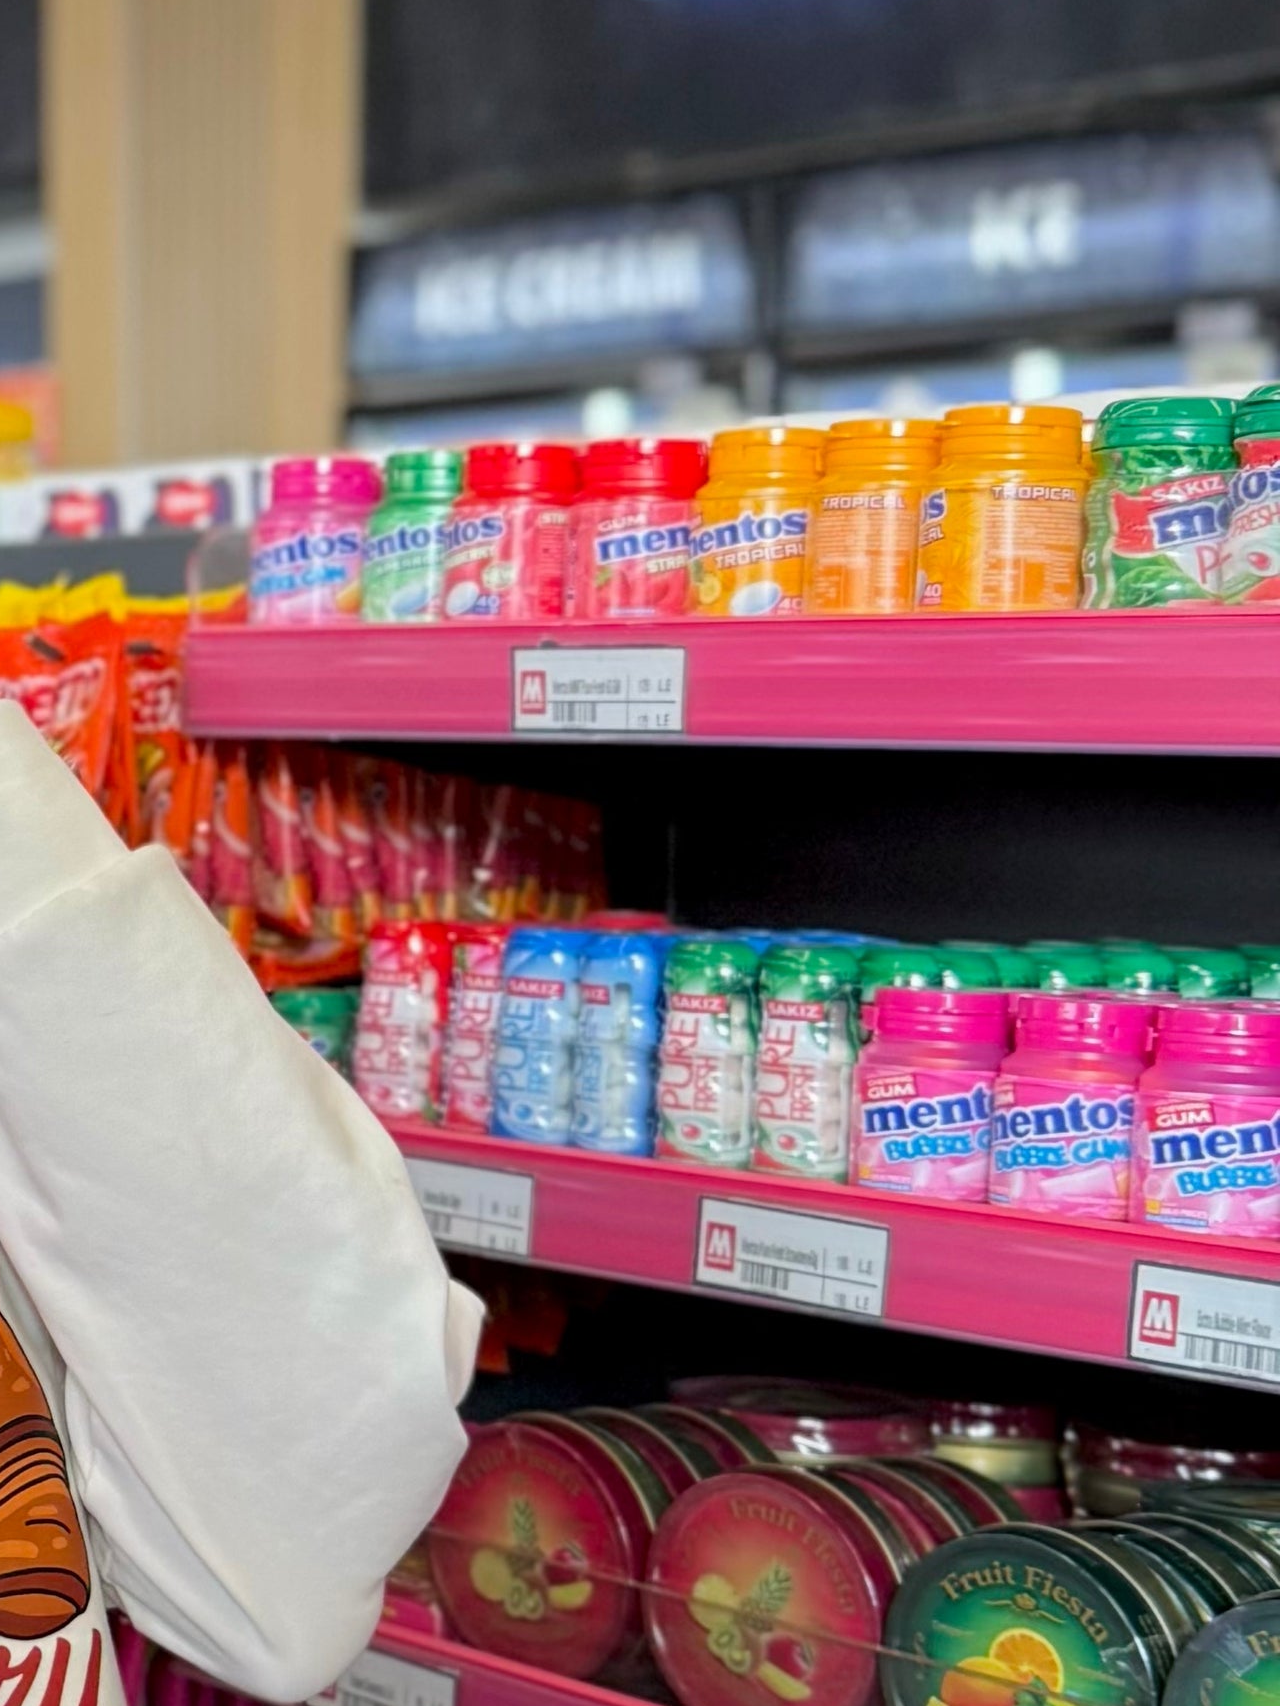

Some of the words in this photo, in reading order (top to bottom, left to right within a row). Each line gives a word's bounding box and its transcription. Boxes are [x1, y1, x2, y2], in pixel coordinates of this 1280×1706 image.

[822, 495, 906, 511] TROPICAL
[992, 485, 1078, 503] TROPICAL
[1151, 476, 1225, 503] SAKIZ
[253, 530, 359, 571] entos
[596, 525, 691, 561] men
[715, 543, 806, 570] TROPICAL
[672, 994, 725, 1012] SAKIZ
[768, 1002, 823, 1021] SAKIZ
[451, 992, 493, 1082] PURE
[498, 1000, 537, 1092] PURE
[661, 1015, 700, 1112] PURE
[758, 1024, 796, 1121] PURE
[866, 1083, 915, 1100] GUM
[863, 1086, 991, 1134] ment
[1156, 1109, 1212, 1127] GUM
[940, 1561, 1014, 1601] Fruit
[1023, 1564, 1111, 1646] Fiesta
